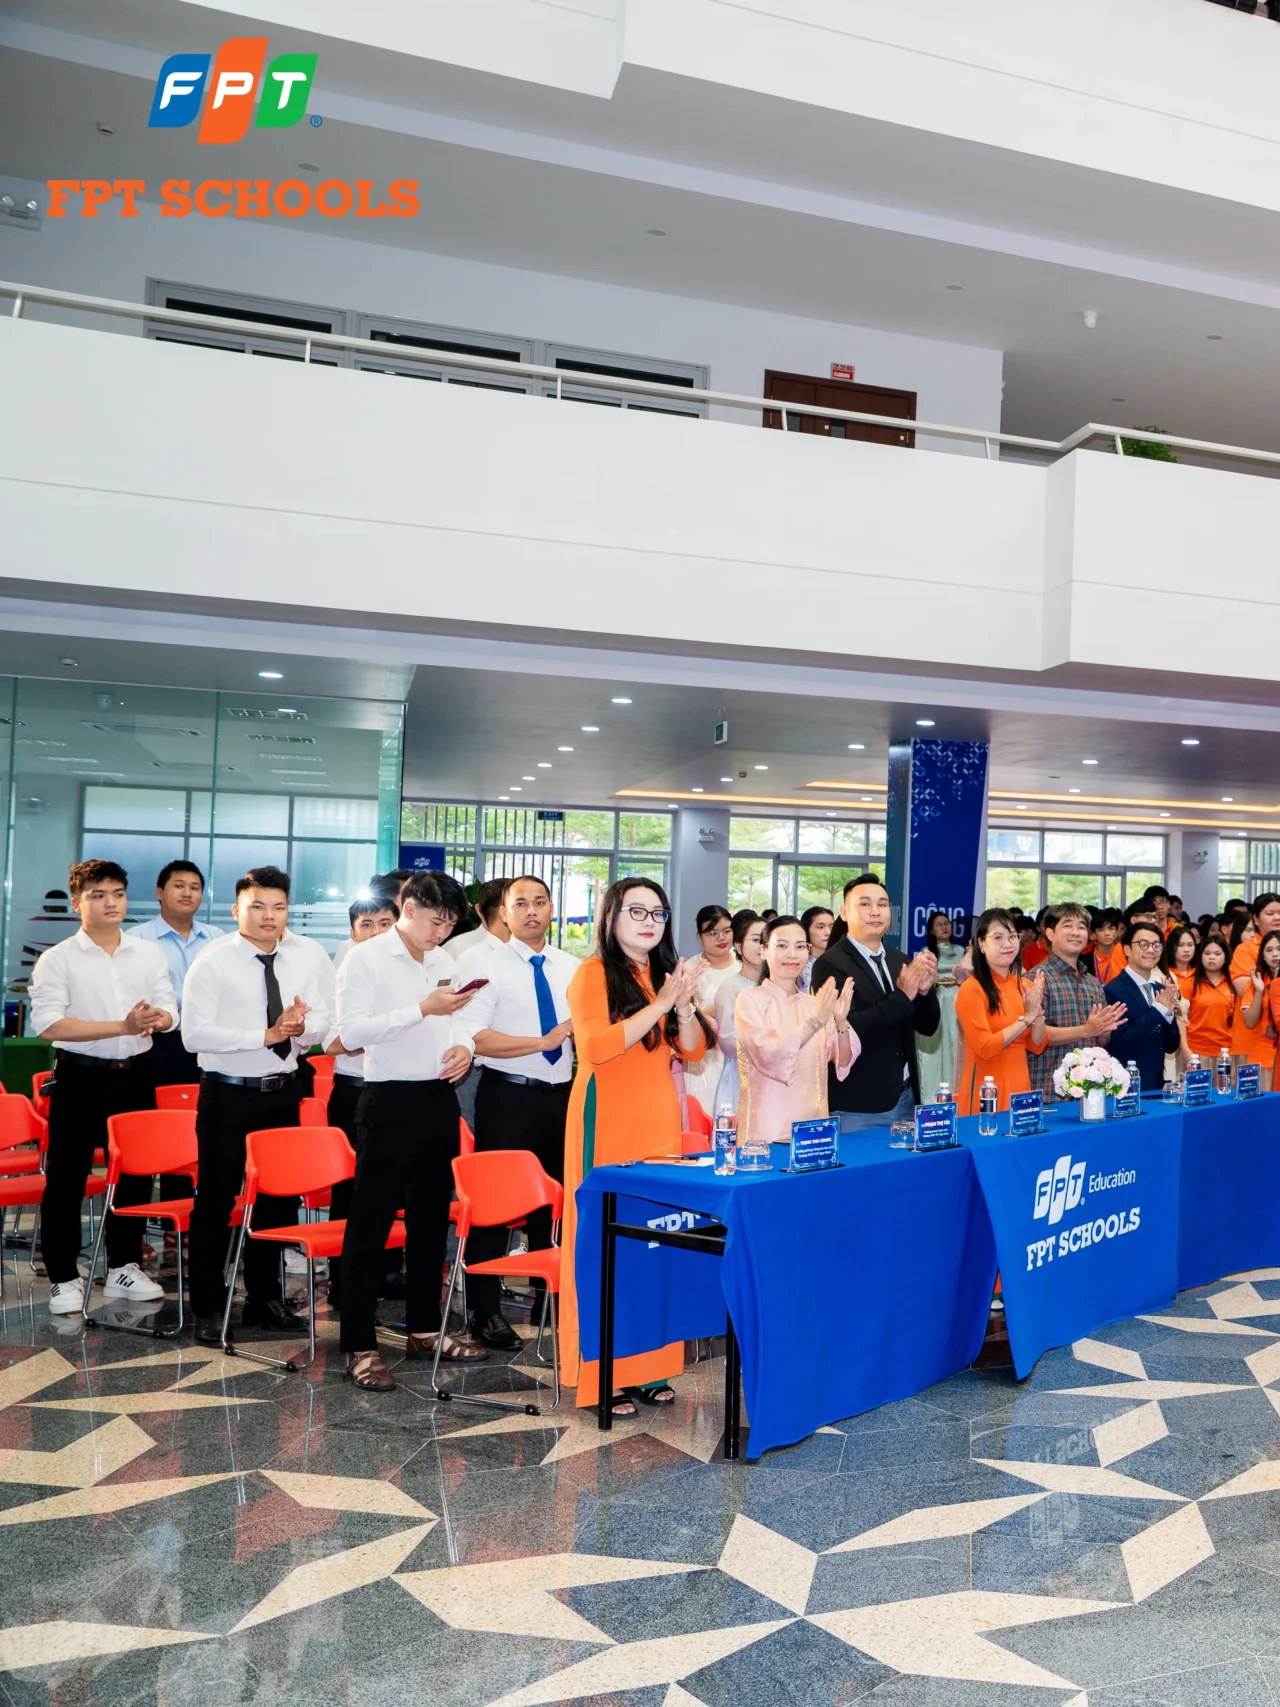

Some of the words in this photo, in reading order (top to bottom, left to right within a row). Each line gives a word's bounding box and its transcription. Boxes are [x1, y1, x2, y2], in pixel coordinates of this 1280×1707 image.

[1088, 1167, 1136, 1193] Education
[1026, 1236, 1056, 1271] FPT
[1058, 1206, 1141, 1257] SCHOOLS
